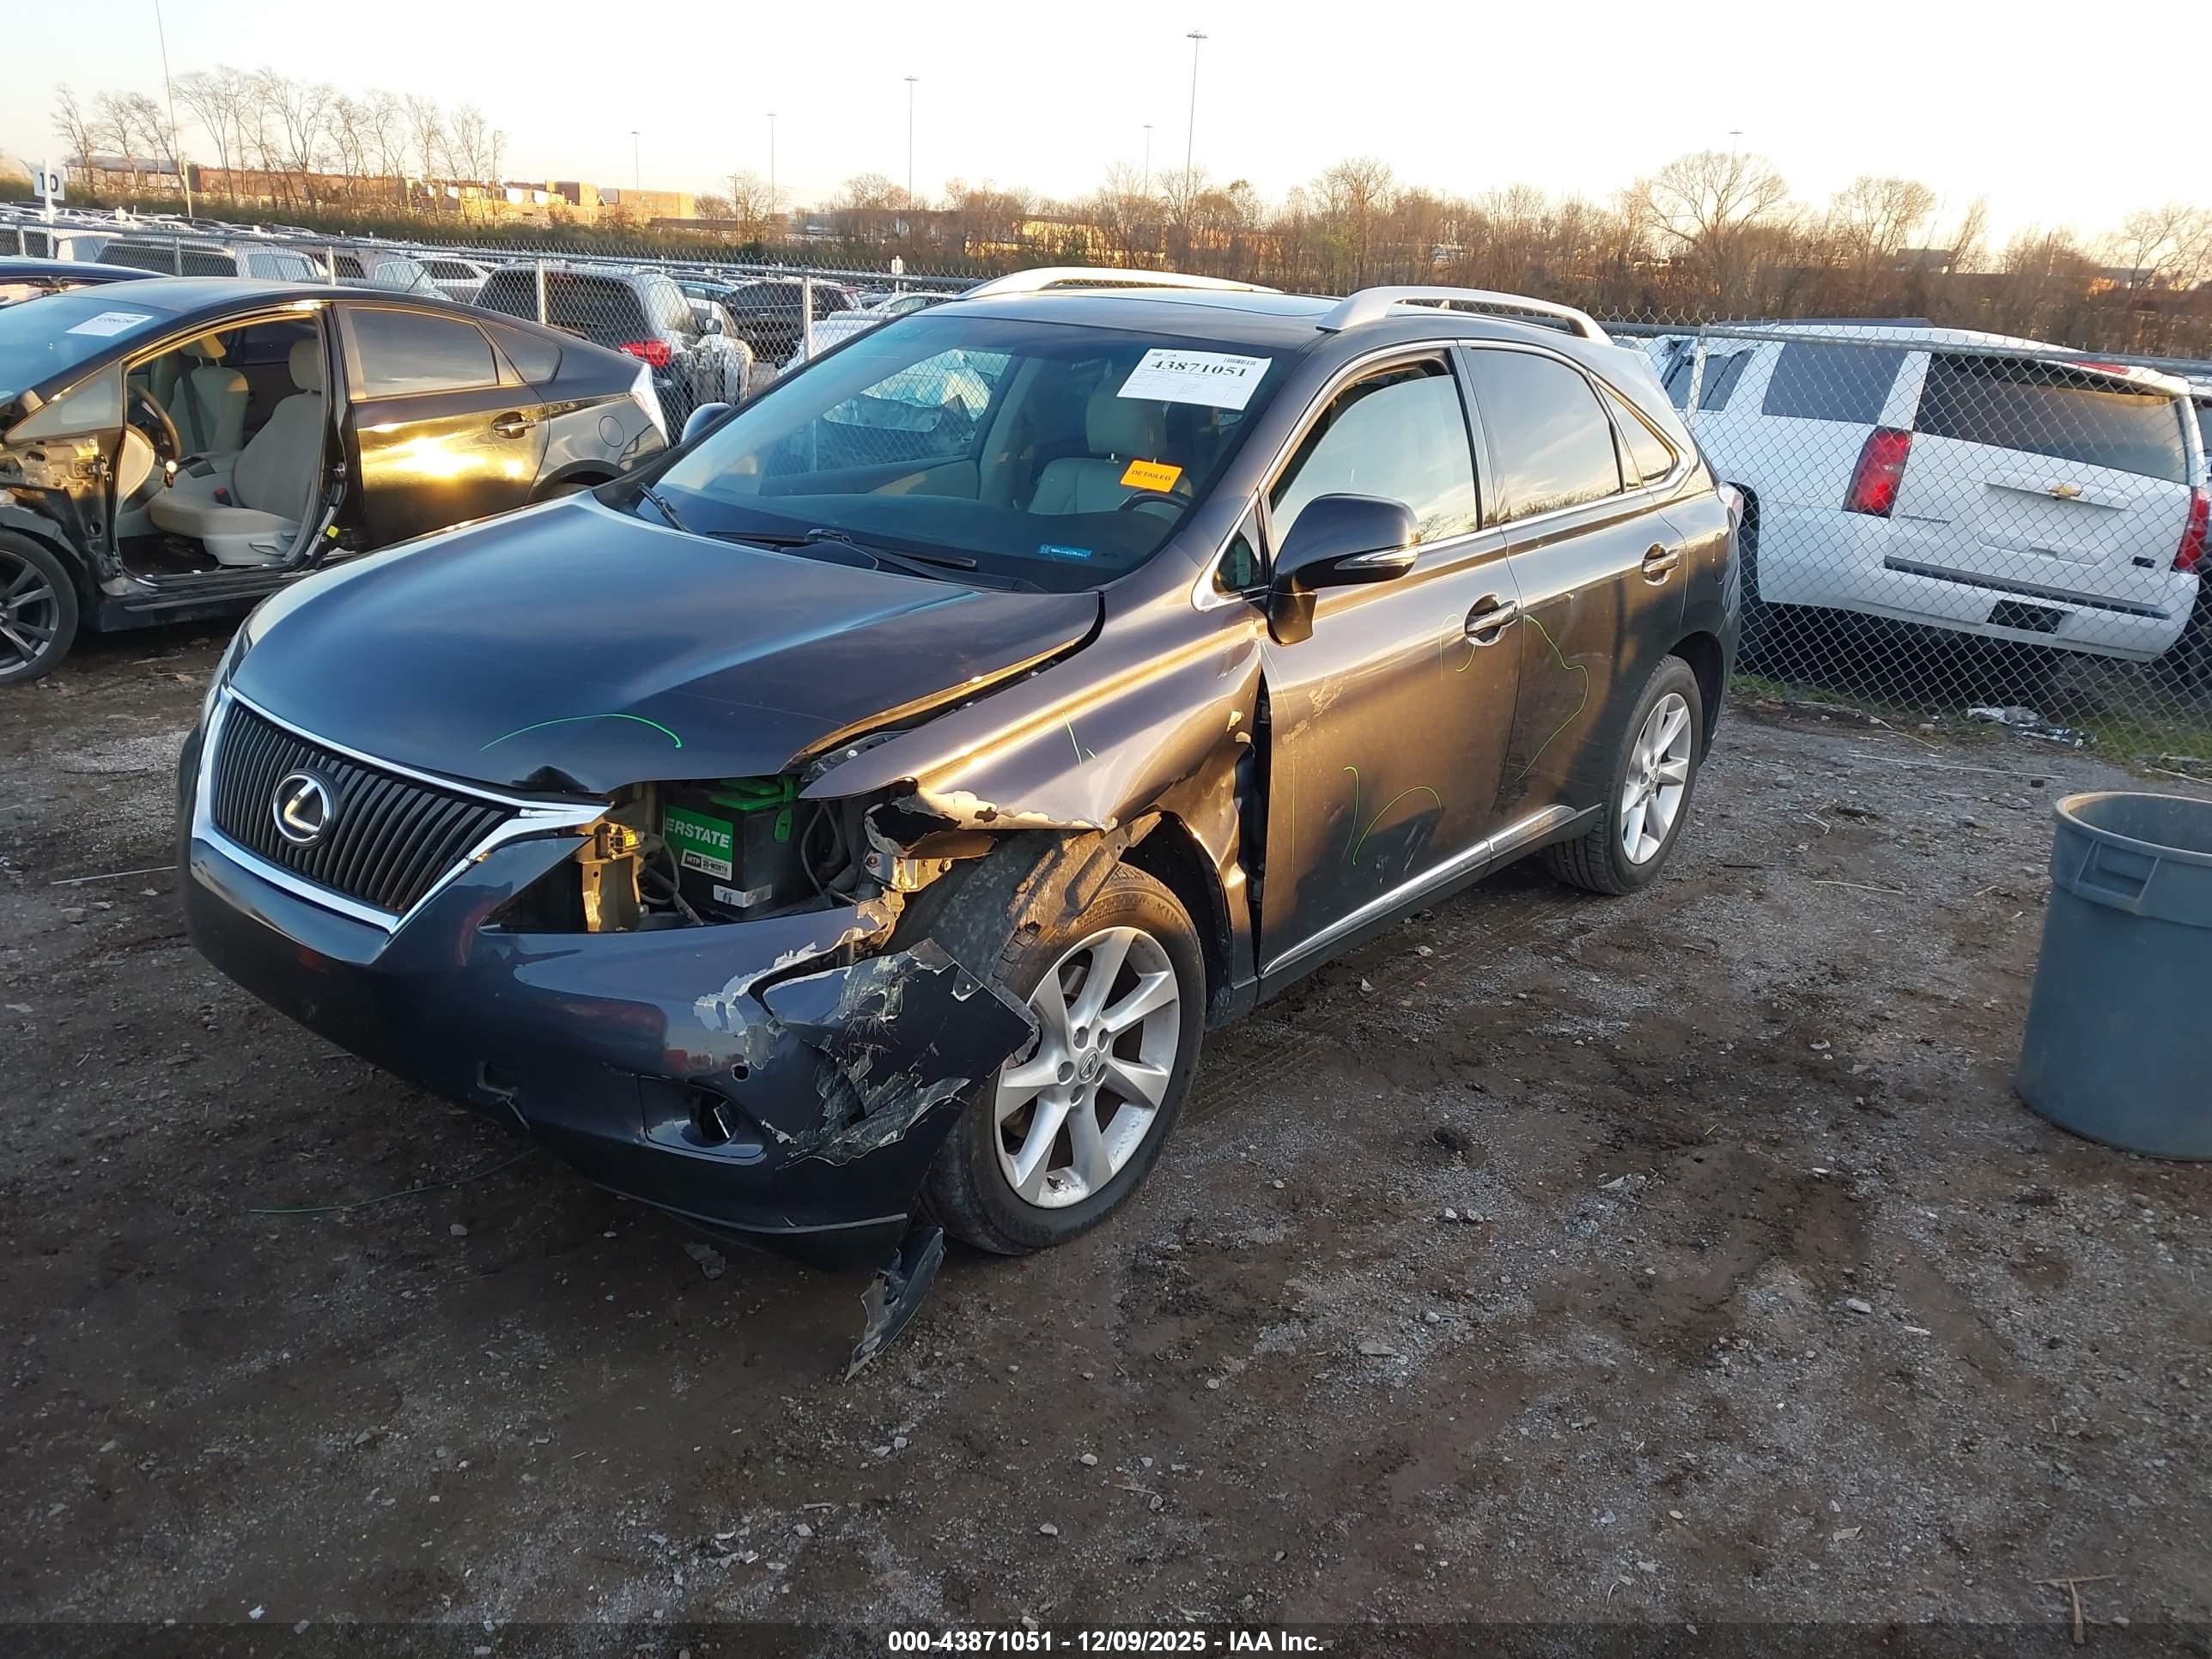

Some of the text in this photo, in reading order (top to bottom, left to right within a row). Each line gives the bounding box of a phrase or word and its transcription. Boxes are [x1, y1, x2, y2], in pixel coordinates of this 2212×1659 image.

[40, 172, 58, 192] 10
[1151, 360, 1248, 377] 43871051
[1131, 470, 1171, 481] DETAILED
